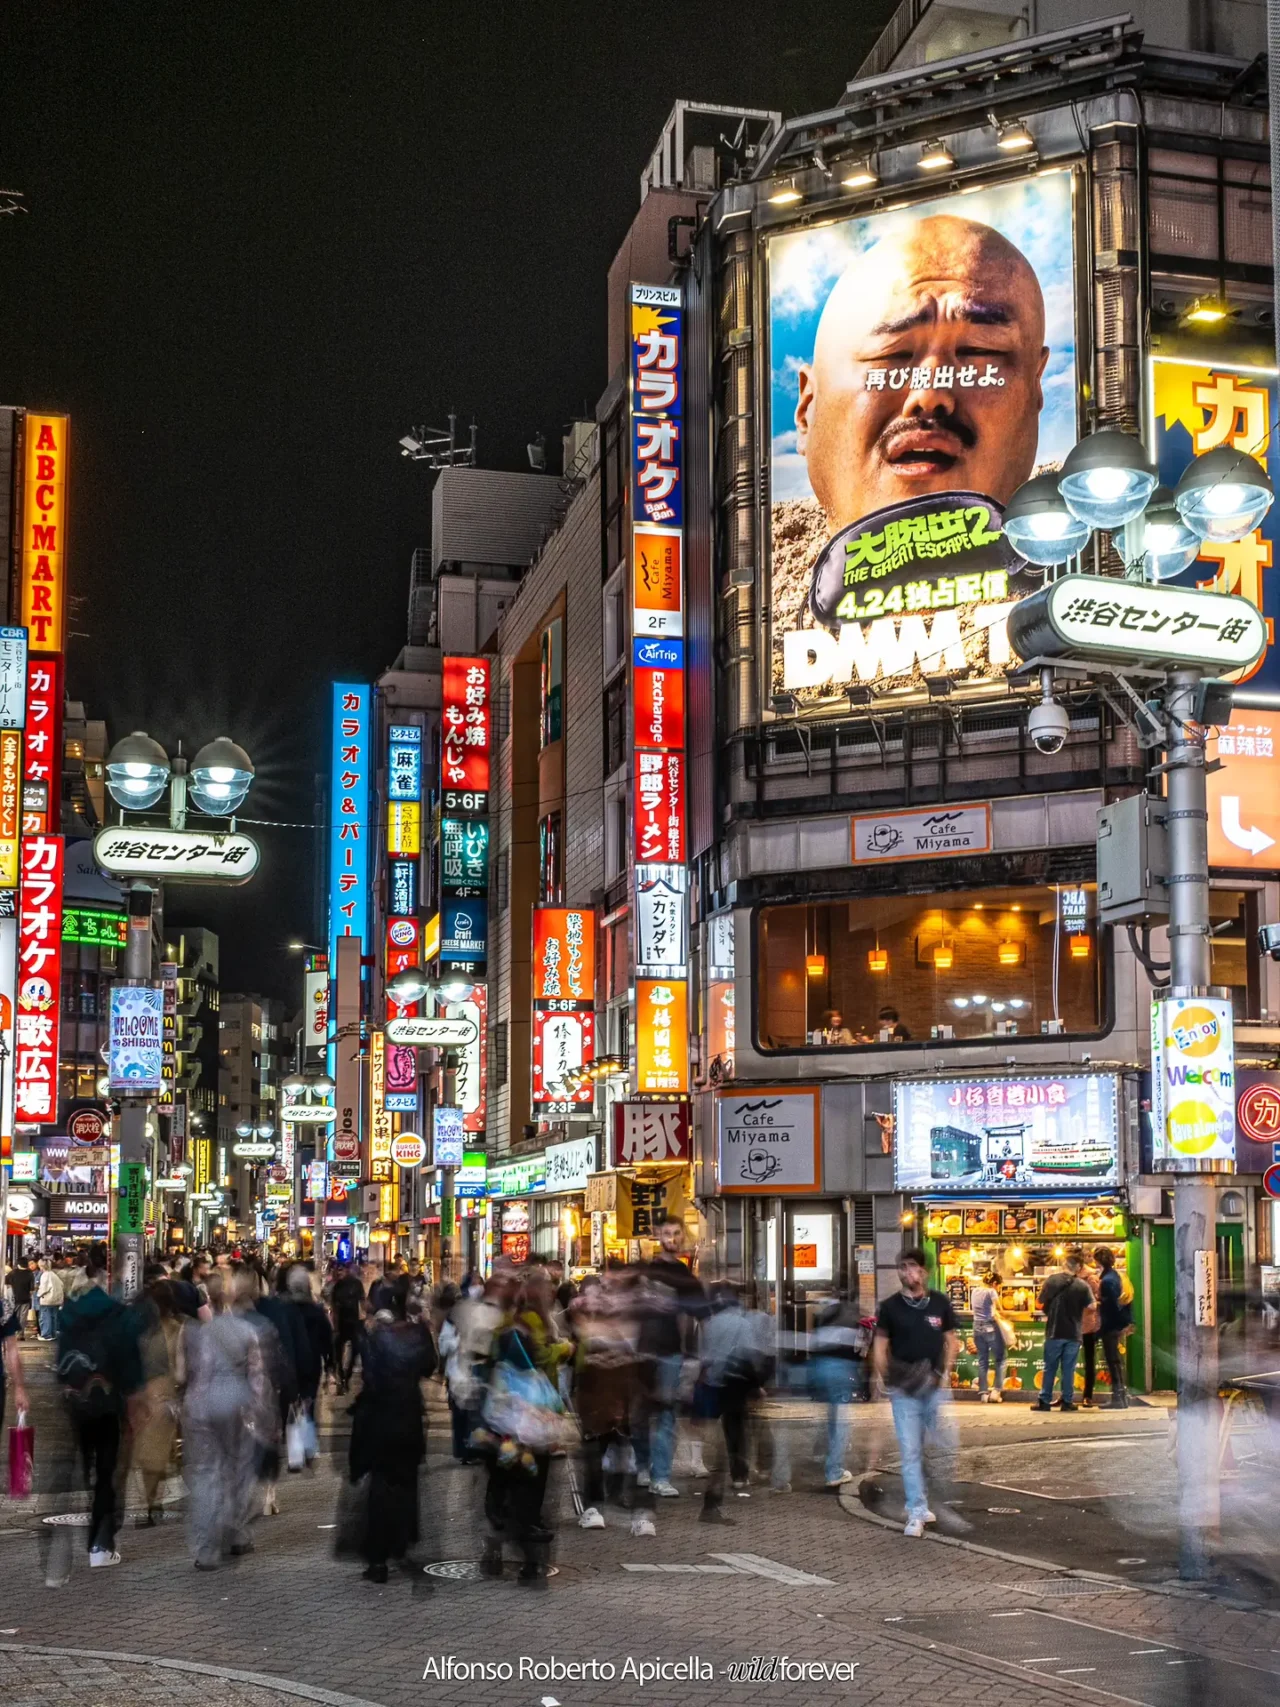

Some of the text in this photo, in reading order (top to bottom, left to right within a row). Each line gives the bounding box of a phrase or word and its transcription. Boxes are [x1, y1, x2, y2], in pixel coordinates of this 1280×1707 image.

[635, 288, 678, 302] プリンスビル
[866, 366, 1007, 391] 再び脱出せよ。
[637, 329, 678, 501] カラオケ
[645, 501, 667, 514] Ban
[652, 509, 674, 522] Ban
[844, 506, 1003, 567] 大脱出2
[650, 558, 660, 585] Cafe
[661, 546, 673, 600] Miyama
[843, 534, 972, 588] THE GREAT ESCAPE
[1, 628, 24, 638] CBR
[648, 616, 667, 629] 2F
[1060, 597, 1252, 644] 渋谷センター街
[645, 648, 678, 662] AirTrip
[783, 611, 967, 690] DMM
[0, 641, 13, 716] モニタールーム
[465, 666, 487, 747] お好み焼
[649, 671, 665, 743] Exchange
[2, 718, 17, 727] 5F
[27, 669, 51, 781] カラオケ
[1220, 725, 1273, 735] マーラータン
[444, 705, 467, 784] もんじゃ
[396, 751, 414, 791] 麻雀
[2, 736, 18, 836] 全身もみほぐし
[667, 756, 680, 828] 渋谷センター街
[639, 753, 664, 859] 野郎ラーメン
[915, 834, 971, 851] Miyama
[930, 823, 957, 835] Cafe
[103, 841, 250, 864] 渋谷センター街
[444, 822, 463, 878] 無呼吸
[466, 822, 489, 878] いびき
[393, 862, 409, 915] 一軒め酒場
[455, 887, 472, 897] 4F
[394, 929, 413, 939] KING
[441, 939, 486, 950] CHEESE MARKET
[454, 930, 472, 940] Craft
[652, 900, 669, 960] カンダヤ
[542, 937, 562, 997] お好み焼
[565, 912, 584, 998] 築地もんじゃ
[16, 836, 57, 1115] カラオケ 歌広場
[113, 1015, 159, 1037] WELCOME
[392, 1025, 473, 1037] 渋谷センター街
[1173, 1018, 1218, 1050] Enjoy
[121, 1036, 161, 1048] SHIBUYA
[75, 1122, 100, 1135] 消火栓
[621, 1103, 682, 1162] 豚
[743, 1113, 774, 1125] Cafe
[728, 1130, 790, 1145] Miyama
[395, 1150, 421, 1158] KING
